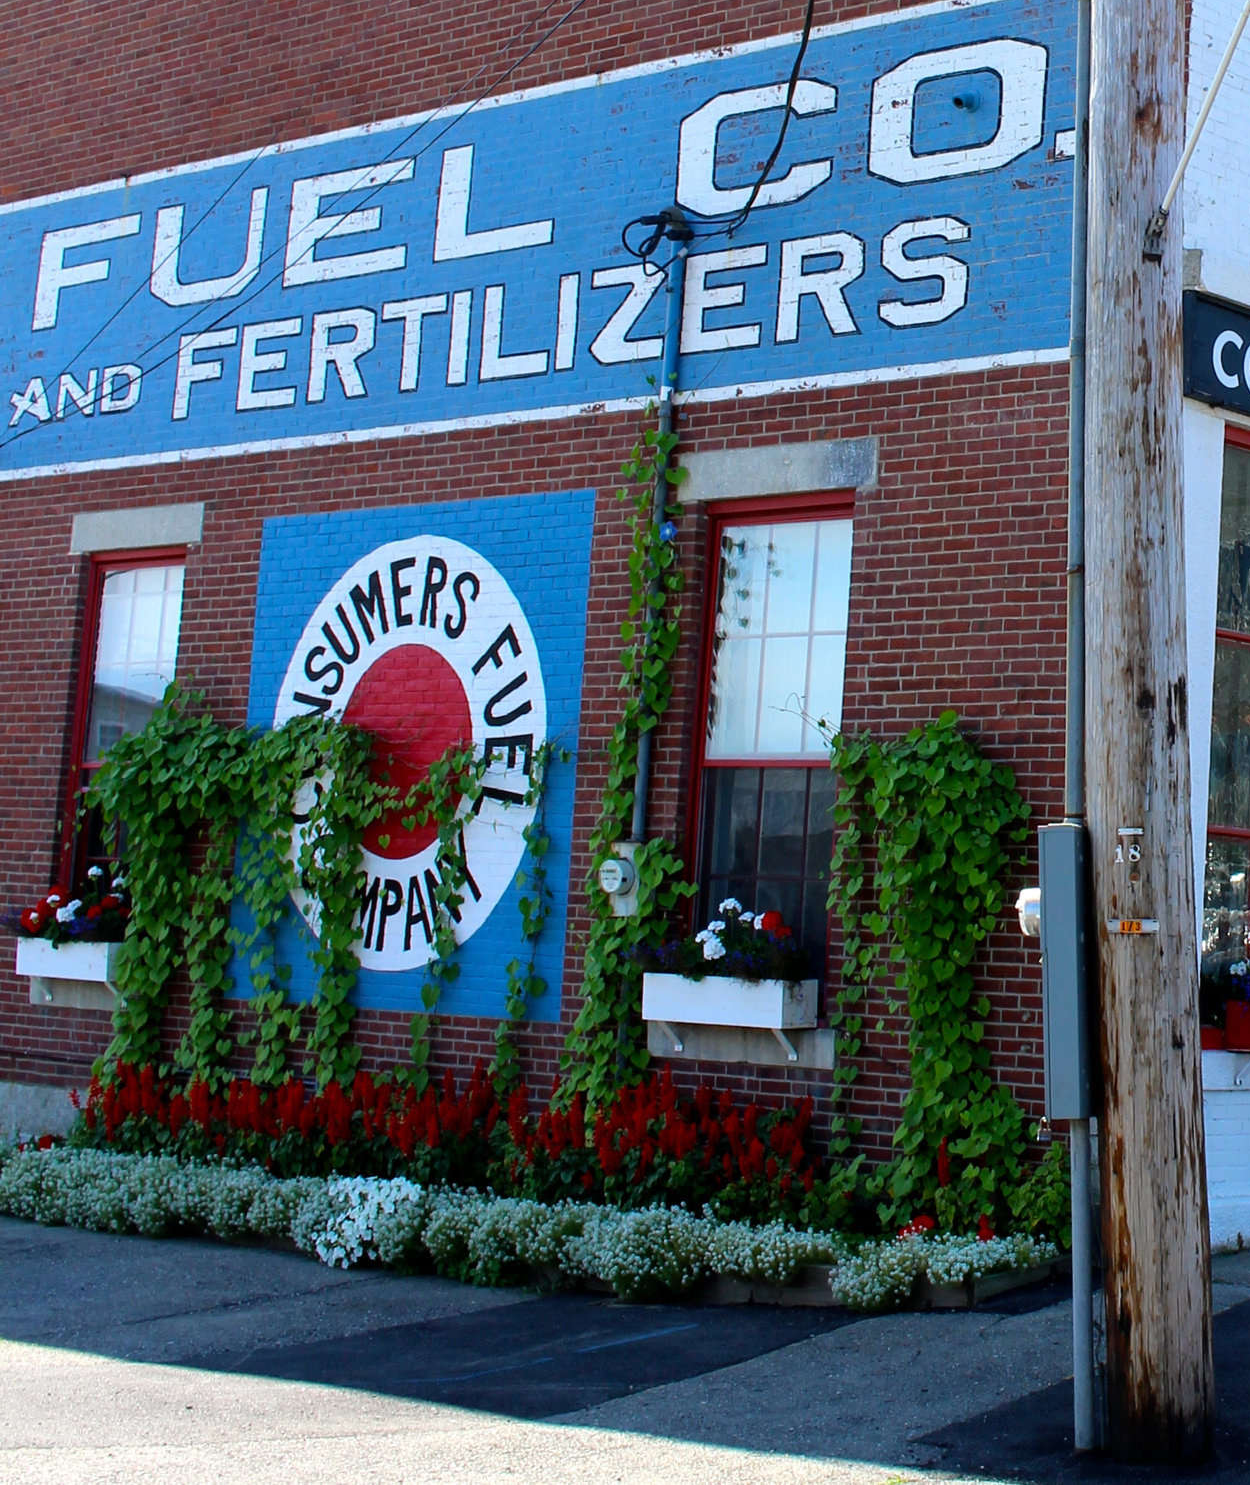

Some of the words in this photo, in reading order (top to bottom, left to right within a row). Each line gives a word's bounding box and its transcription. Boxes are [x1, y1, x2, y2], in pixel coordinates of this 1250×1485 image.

[31, 143, 554, 332] FUEL
[675, 37, 1077, 217] CO.
[8, 362, 144, 428] AND
[171, 215, 972, 422] FERTILIZERS
[472, 623, 535, 816] FUEL
[1114, 843, 1141, 863] 18
[1120, 921, 1142, 932] 1/3
